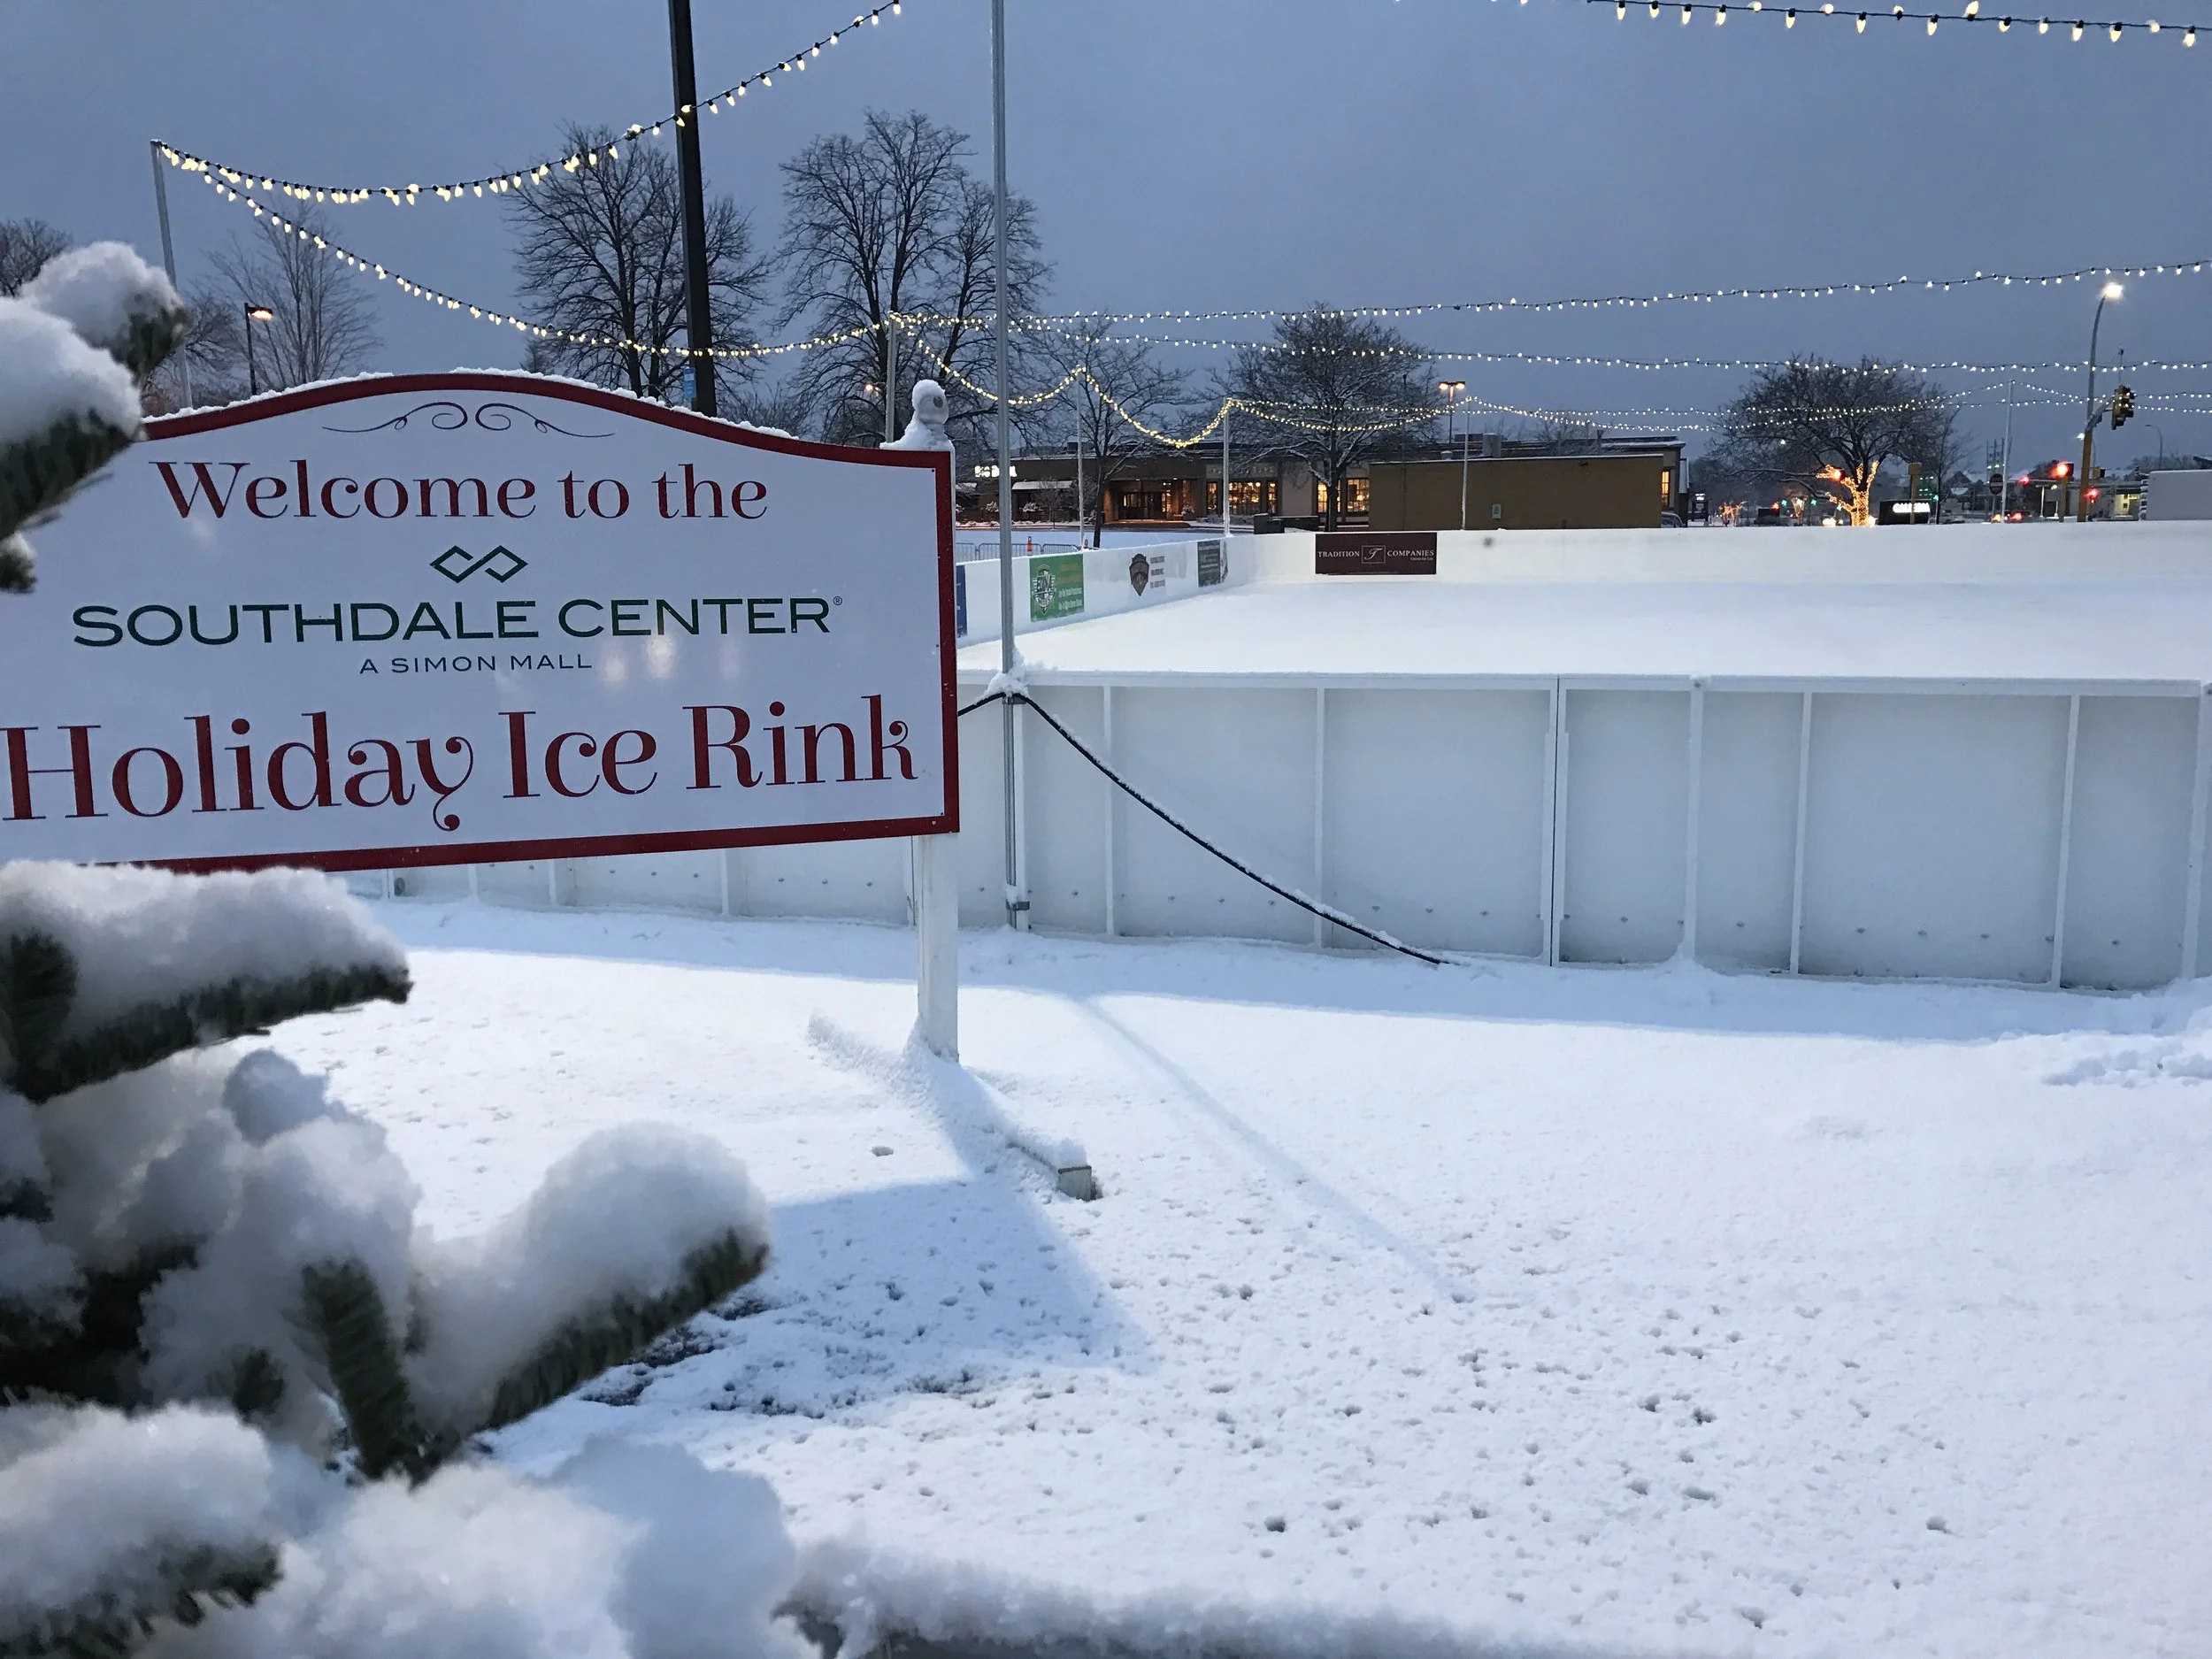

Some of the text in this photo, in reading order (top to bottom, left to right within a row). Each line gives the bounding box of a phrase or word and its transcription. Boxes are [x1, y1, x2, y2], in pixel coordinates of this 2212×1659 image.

[149, 459, 768, 520] Welcome to the
[73, 599, 539, 647] SOUTHDALE
[359, 654, 592, 674] A SIMON MALL
[0, 694, 918, 832] Holiday Ice Rink
